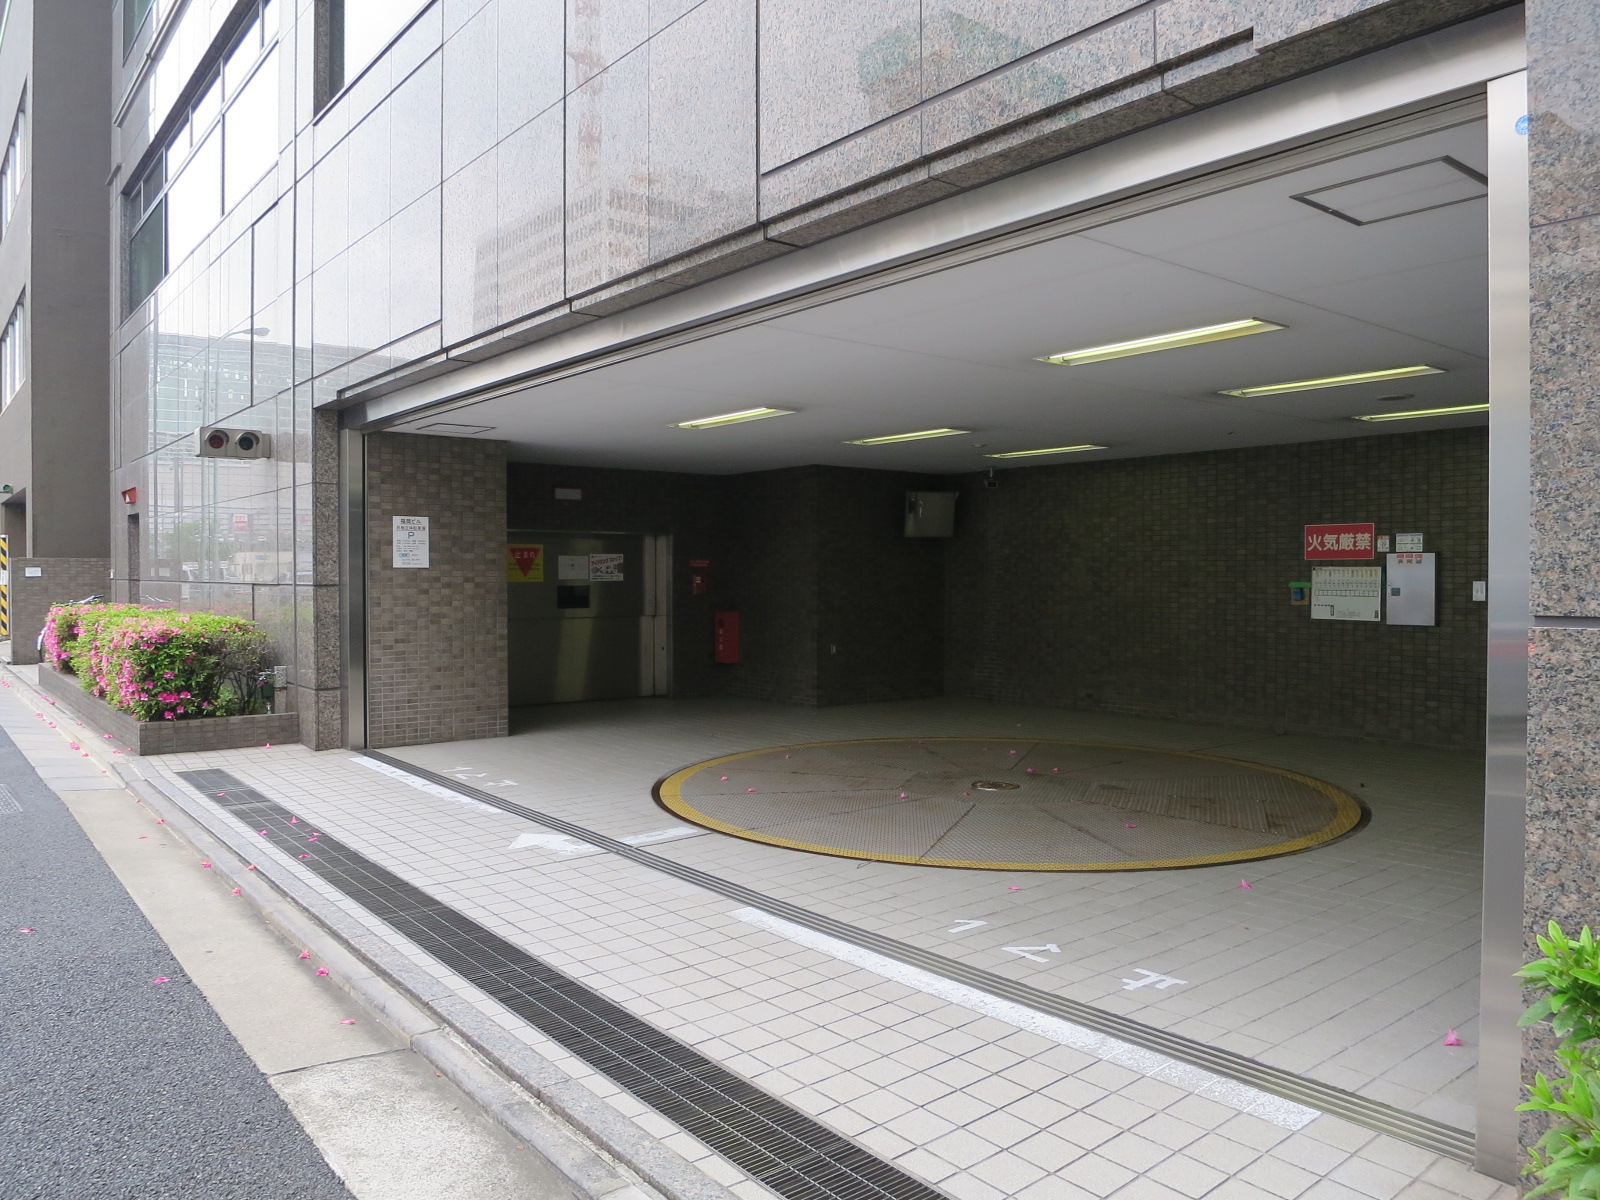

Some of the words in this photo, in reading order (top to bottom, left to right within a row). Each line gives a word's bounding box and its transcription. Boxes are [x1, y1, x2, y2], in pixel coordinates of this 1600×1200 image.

[408, 531, 415, 539] P
[1307, 533, 1371, 551] 火気厳禁
[514, 551, 536, 559] 止まれ
